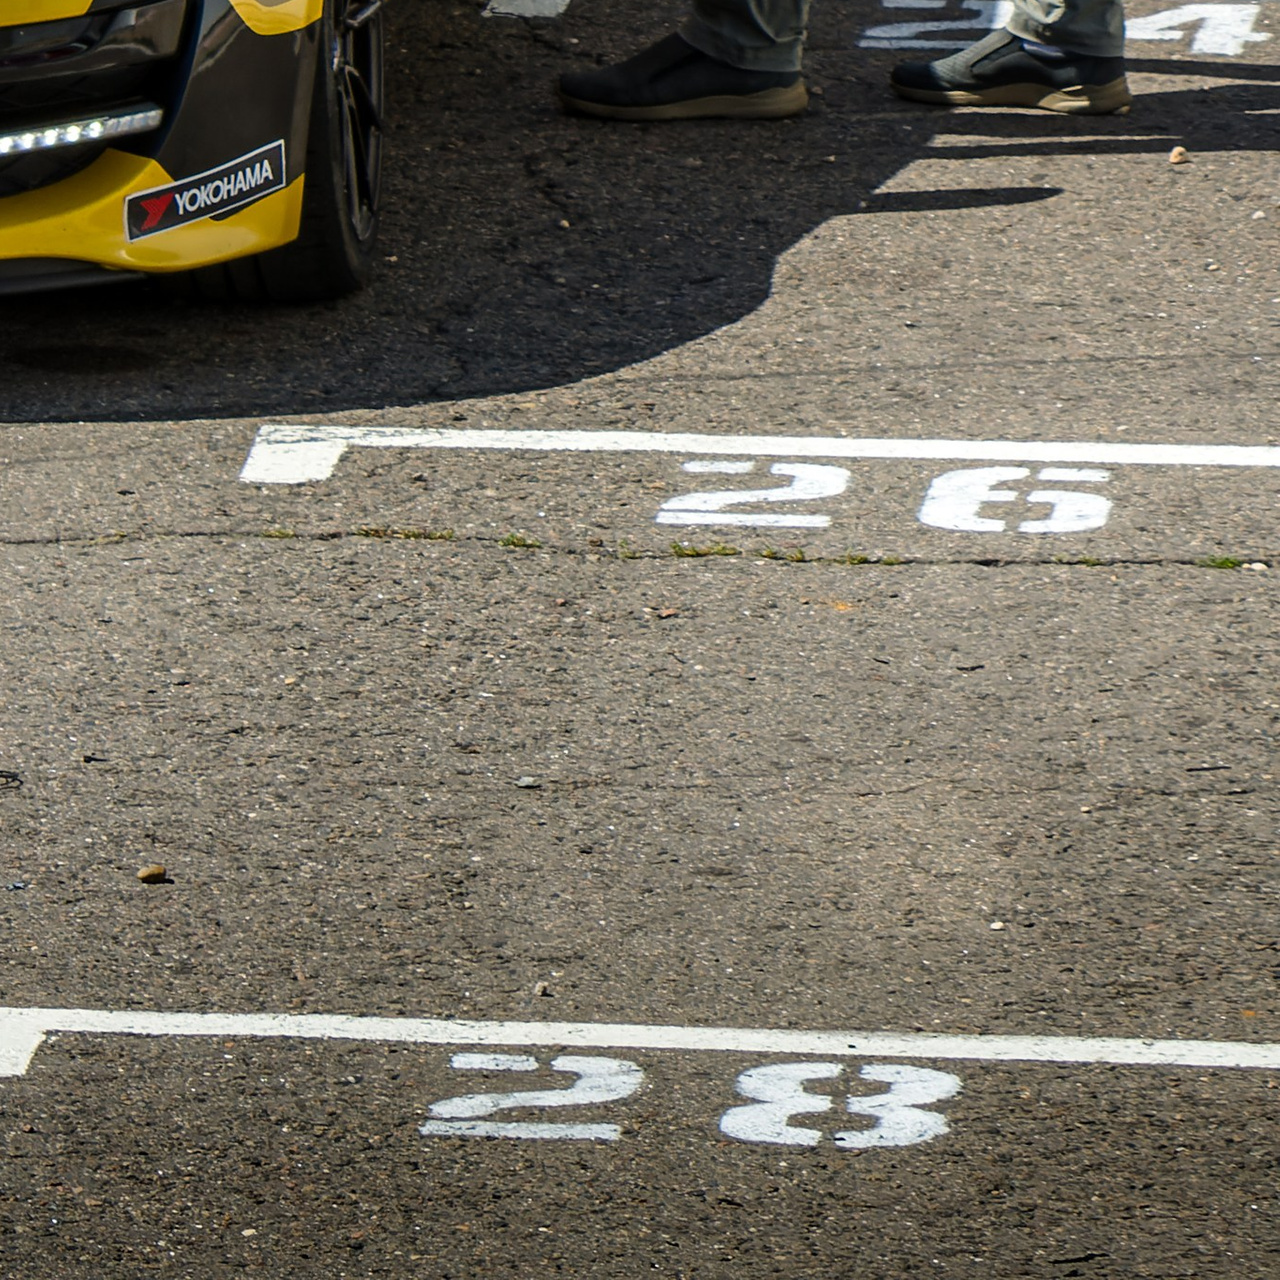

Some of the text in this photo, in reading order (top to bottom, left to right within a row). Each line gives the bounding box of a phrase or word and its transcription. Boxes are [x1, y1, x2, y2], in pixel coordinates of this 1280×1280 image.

[174, 159, 274, 216] YOKOHAMA
[655, 459, 1112, 534] 26
[418, 1052, 963, 1150] 28
